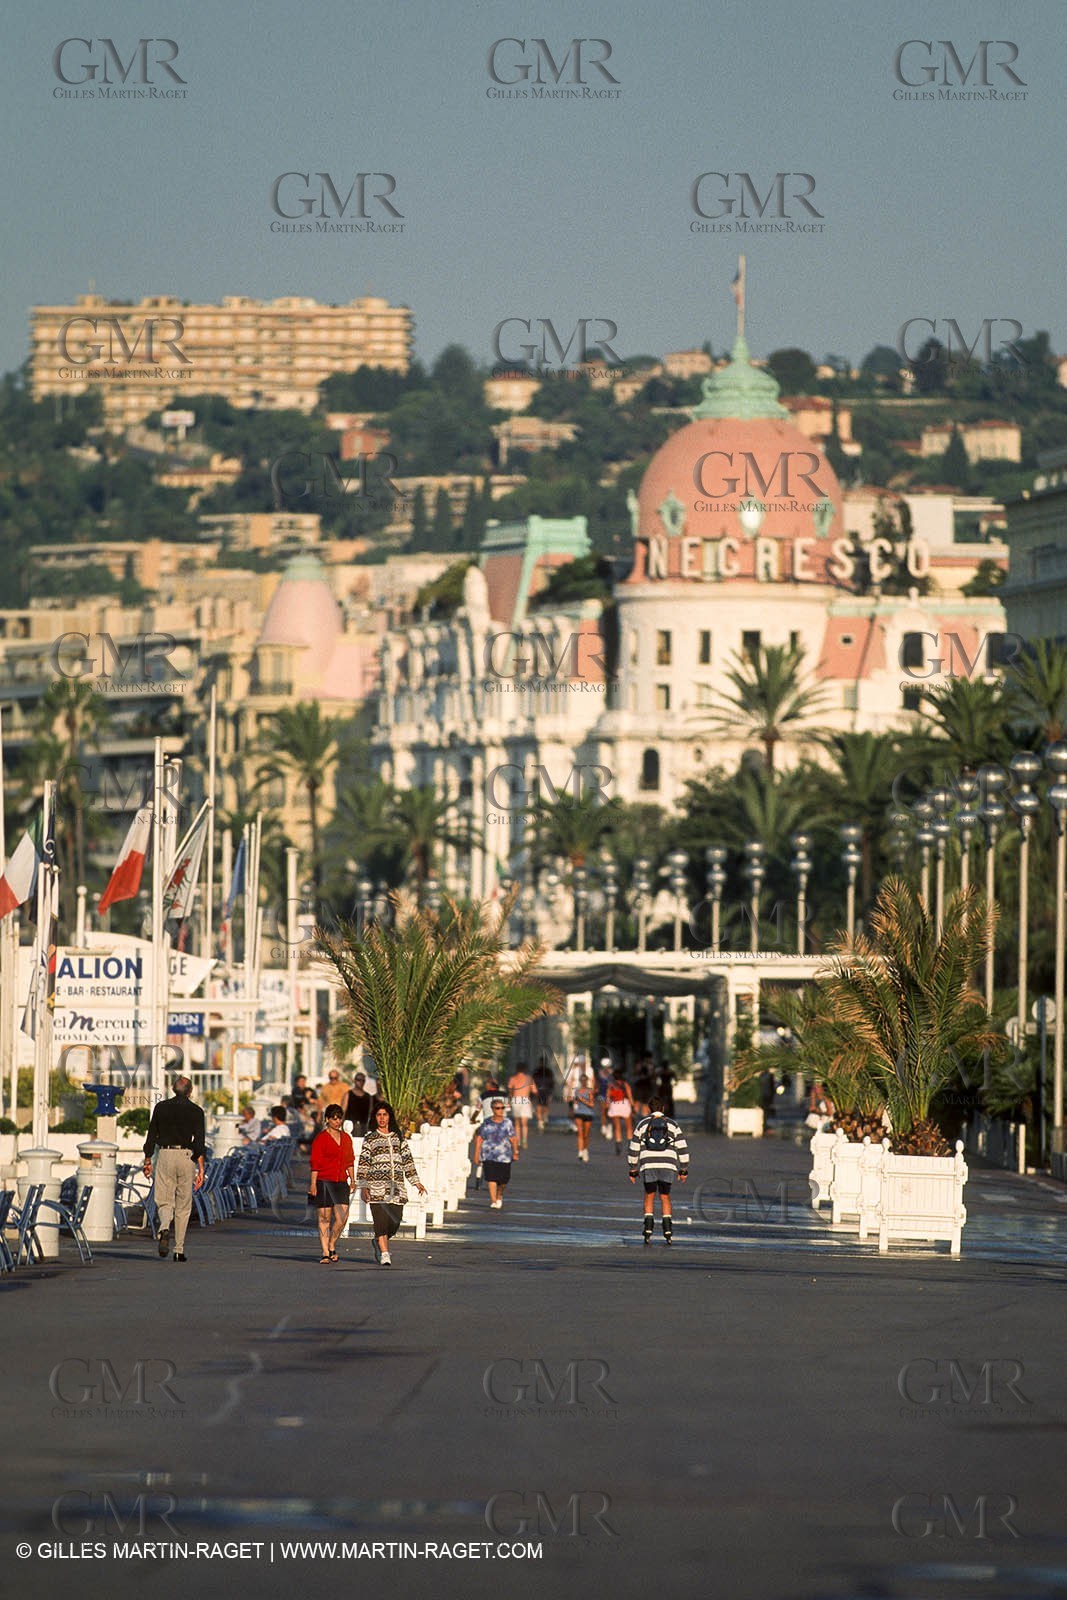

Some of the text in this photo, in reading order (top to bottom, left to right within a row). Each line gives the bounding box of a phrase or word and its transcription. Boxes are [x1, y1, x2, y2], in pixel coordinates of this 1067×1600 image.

[649, 534, 930, 583] NEGRESCO
[67, 985, 85, 996] BAR
[89, 985, 144, 996] RESTAURANT
[68, 1010, 148, 1032] Mercure
